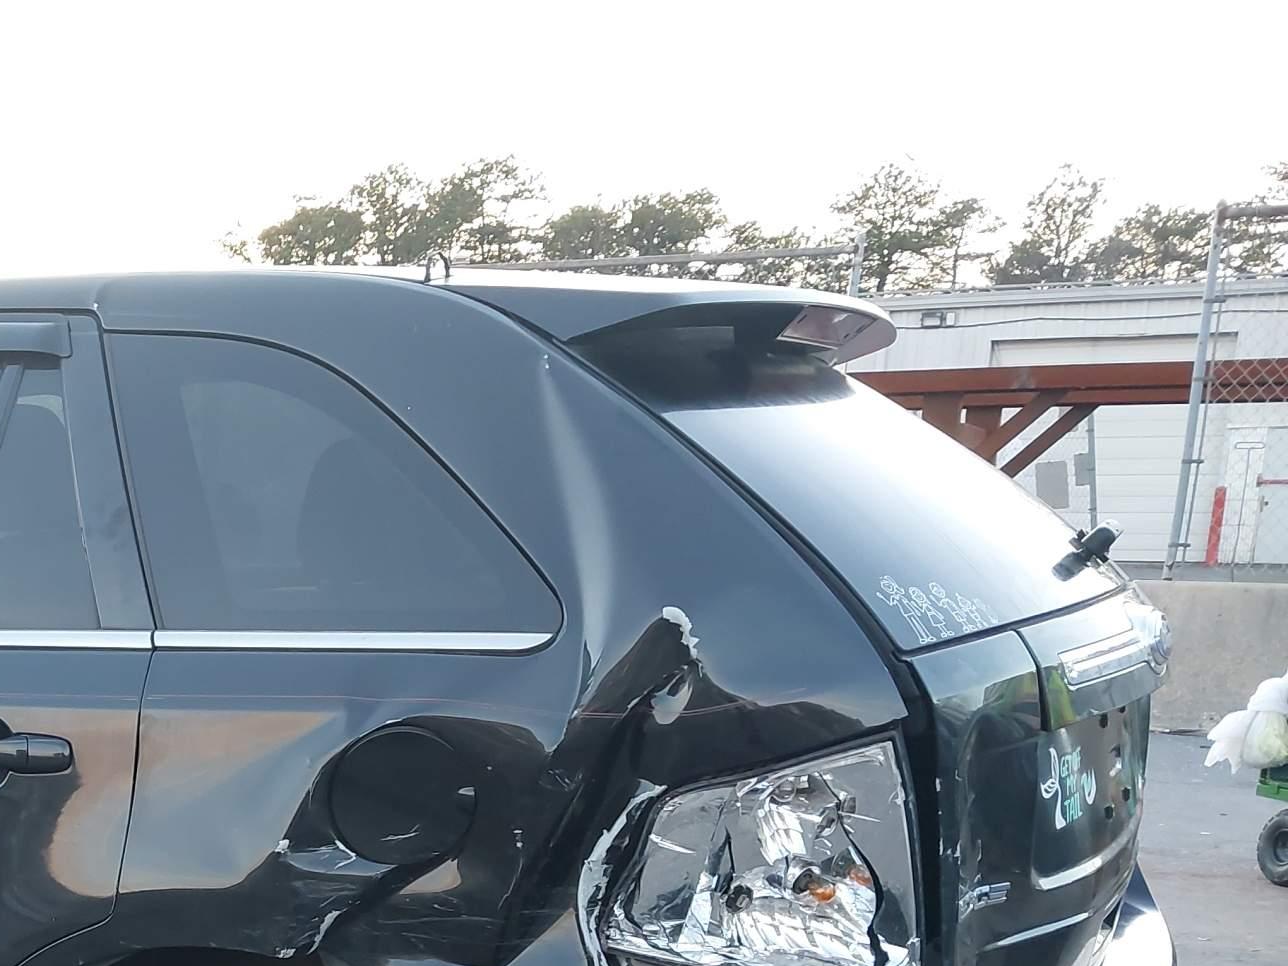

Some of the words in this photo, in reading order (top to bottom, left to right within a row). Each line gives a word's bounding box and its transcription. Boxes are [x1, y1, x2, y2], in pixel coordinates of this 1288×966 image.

[1060, 754, 1072, 778] GET
[1072, 746, 1082, 772] OFF
[1066, 773, 1078, 796] MY
[1063, 792, 1083, 824] TAIL
